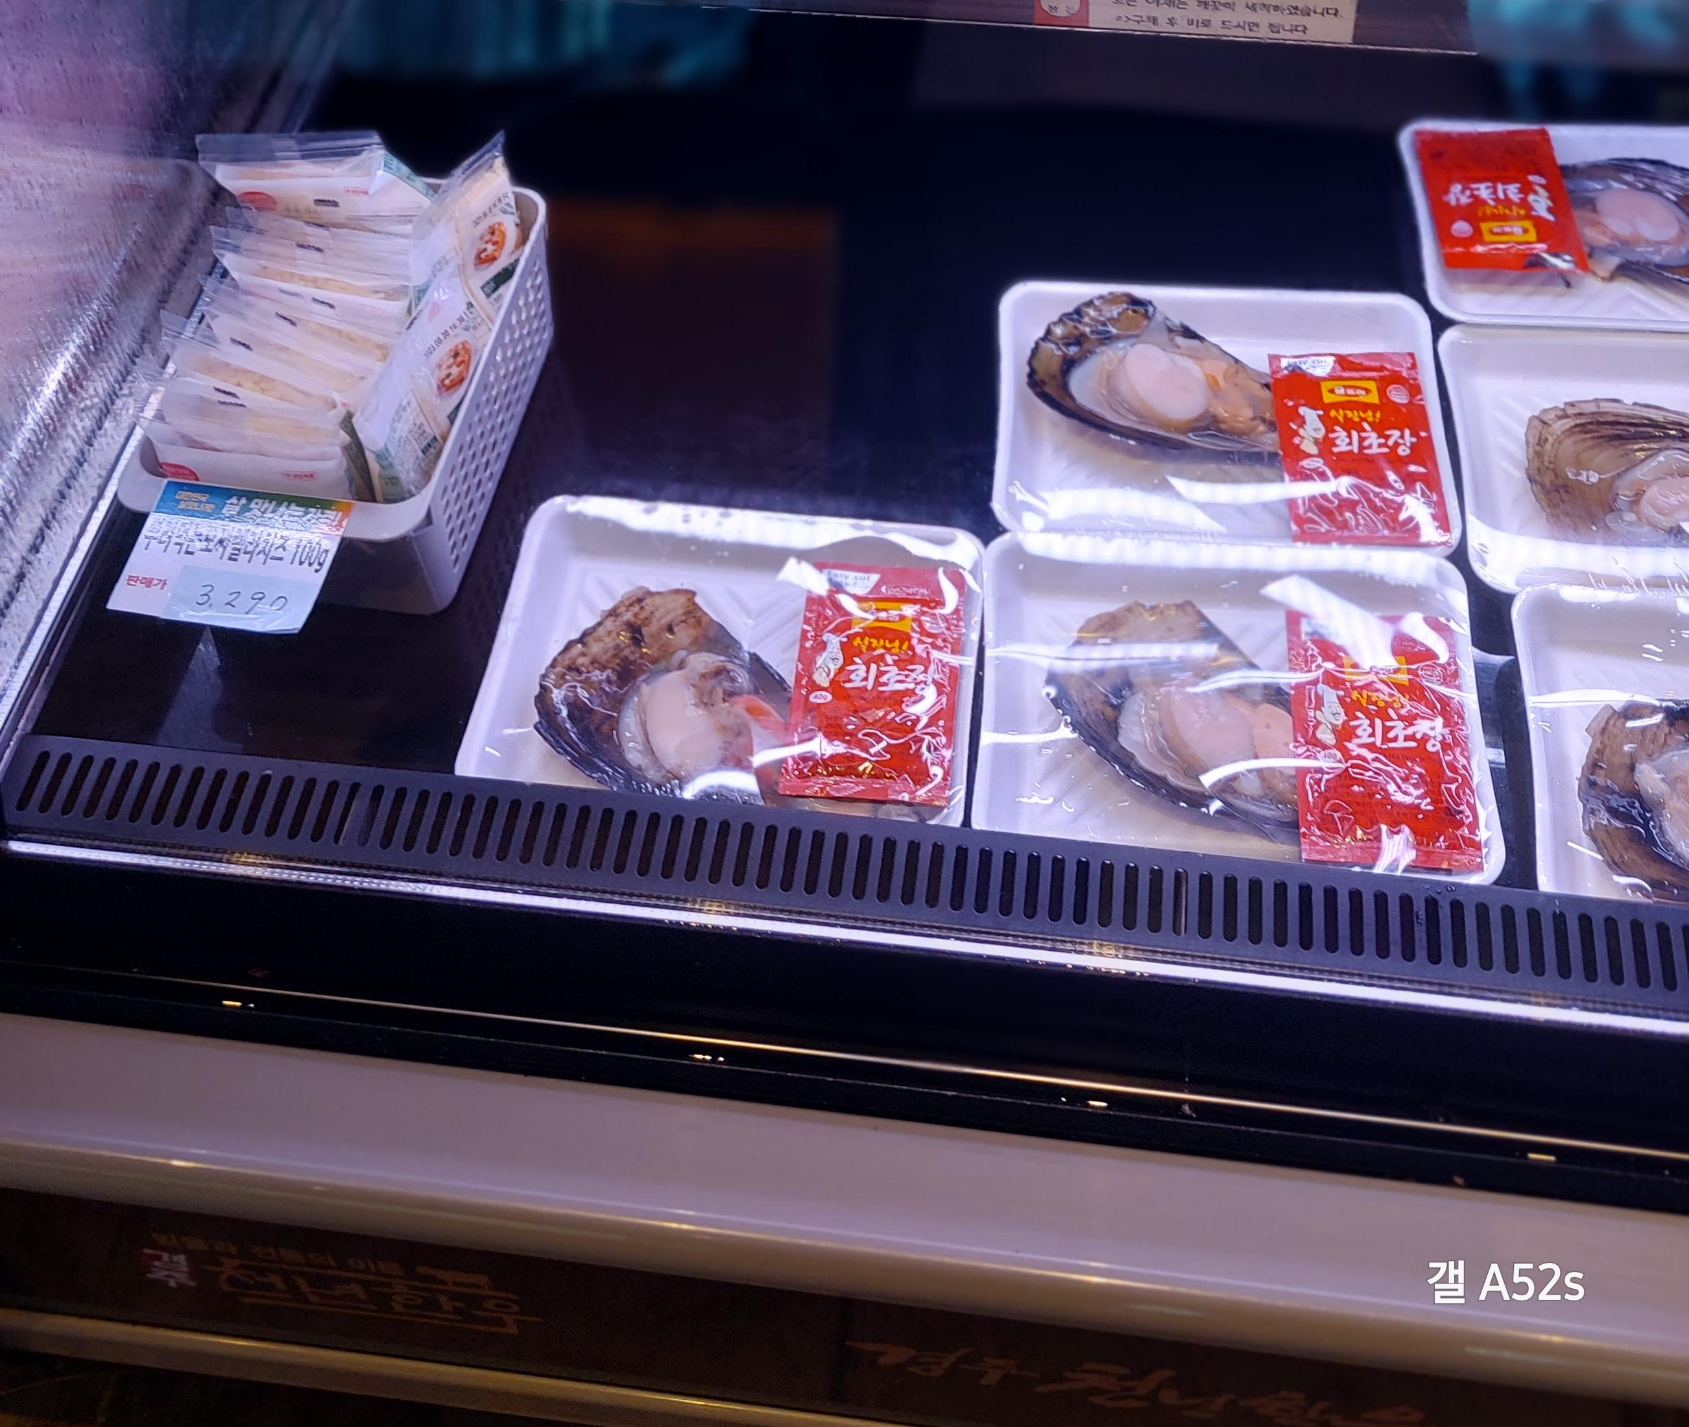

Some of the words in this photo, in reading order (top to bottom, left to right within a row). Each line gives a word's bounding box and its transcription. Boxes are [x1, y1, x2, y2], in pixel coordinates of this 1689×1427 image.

[1221, 20, 1260, 32] 드시면
[1268, 22, 1309, 35] 됩니다
[1328, 421, 1418, 456] 회초장
[289, 537, 331, 574] 100g
[126, 575, 168, 591] 판매가
[1348, 708, 1446, 752] 회초장
